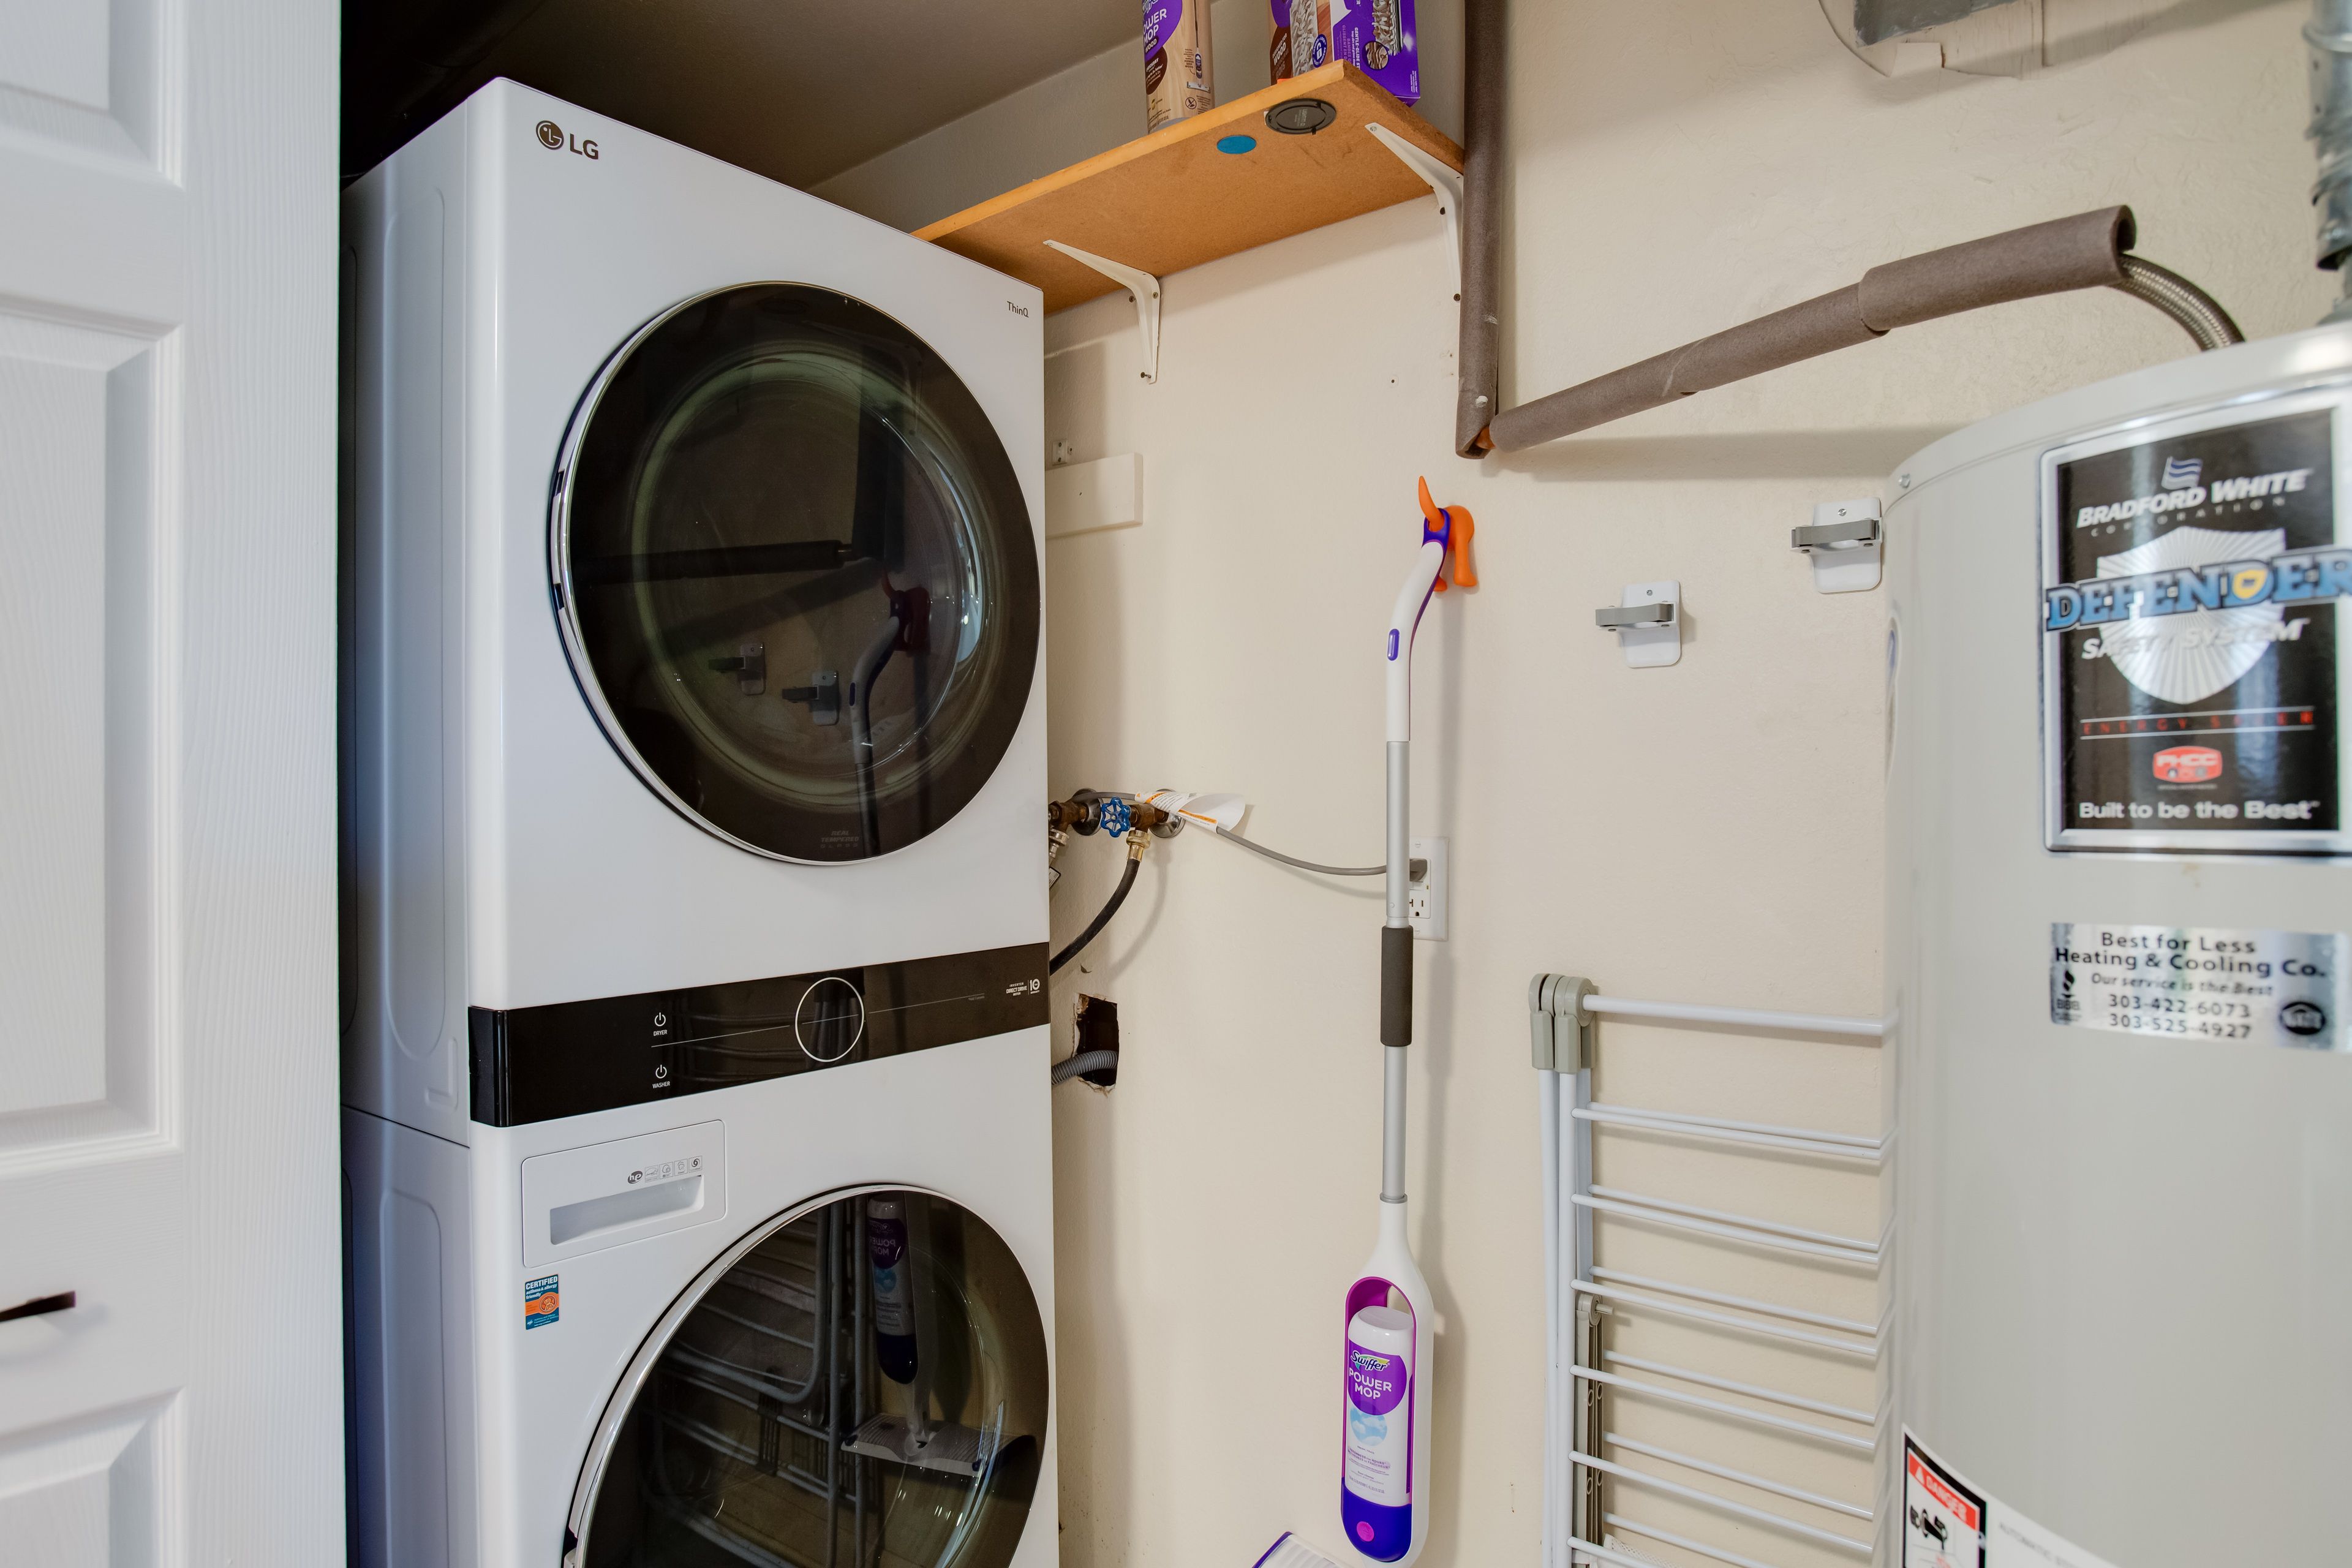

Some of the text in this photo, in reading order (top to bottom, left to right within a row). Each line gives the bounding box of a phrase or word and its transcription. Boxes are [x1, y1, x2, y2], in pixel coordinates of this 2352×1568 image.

[1274, 42, 1286, 66] WOOD
[570, 133, 598, 159] LG
[1006, 301, 1029, 318] ThinQ
[2076, 469, 2312, 529] BRADFORD WHITE
[2083, 717, 2187, 735] ENERGY
[2079, 802, 2125, 818] Built
[2129, 804, 2154, 818] to
[2158, 801, 2190, 819] be
[2195, 801, 2239, 819] the
[2101, 932, 2255, 953] Best for Less
[2055, 948, 2327, 979] Heating & Cooling Co.
[2091, 973, 2117, 985] Our
[2122, 976, 2176, 989] service
[2108, 993, 2252, 1018] 303-422-6073
[2109, 1013, 2252, 1039] 303-525-4927
[652, 1080, 671, 1089] WASHER
[526, 1276, 558, 1290] CERTIFIED
[1351, 1349, 1388, 1371] Swiffer
[1349, 1367, 1392, 1392] POWER
[1355, 1382, 1381, 1400] MOP
[1926, 1476, 1967, 1523] DANGER
